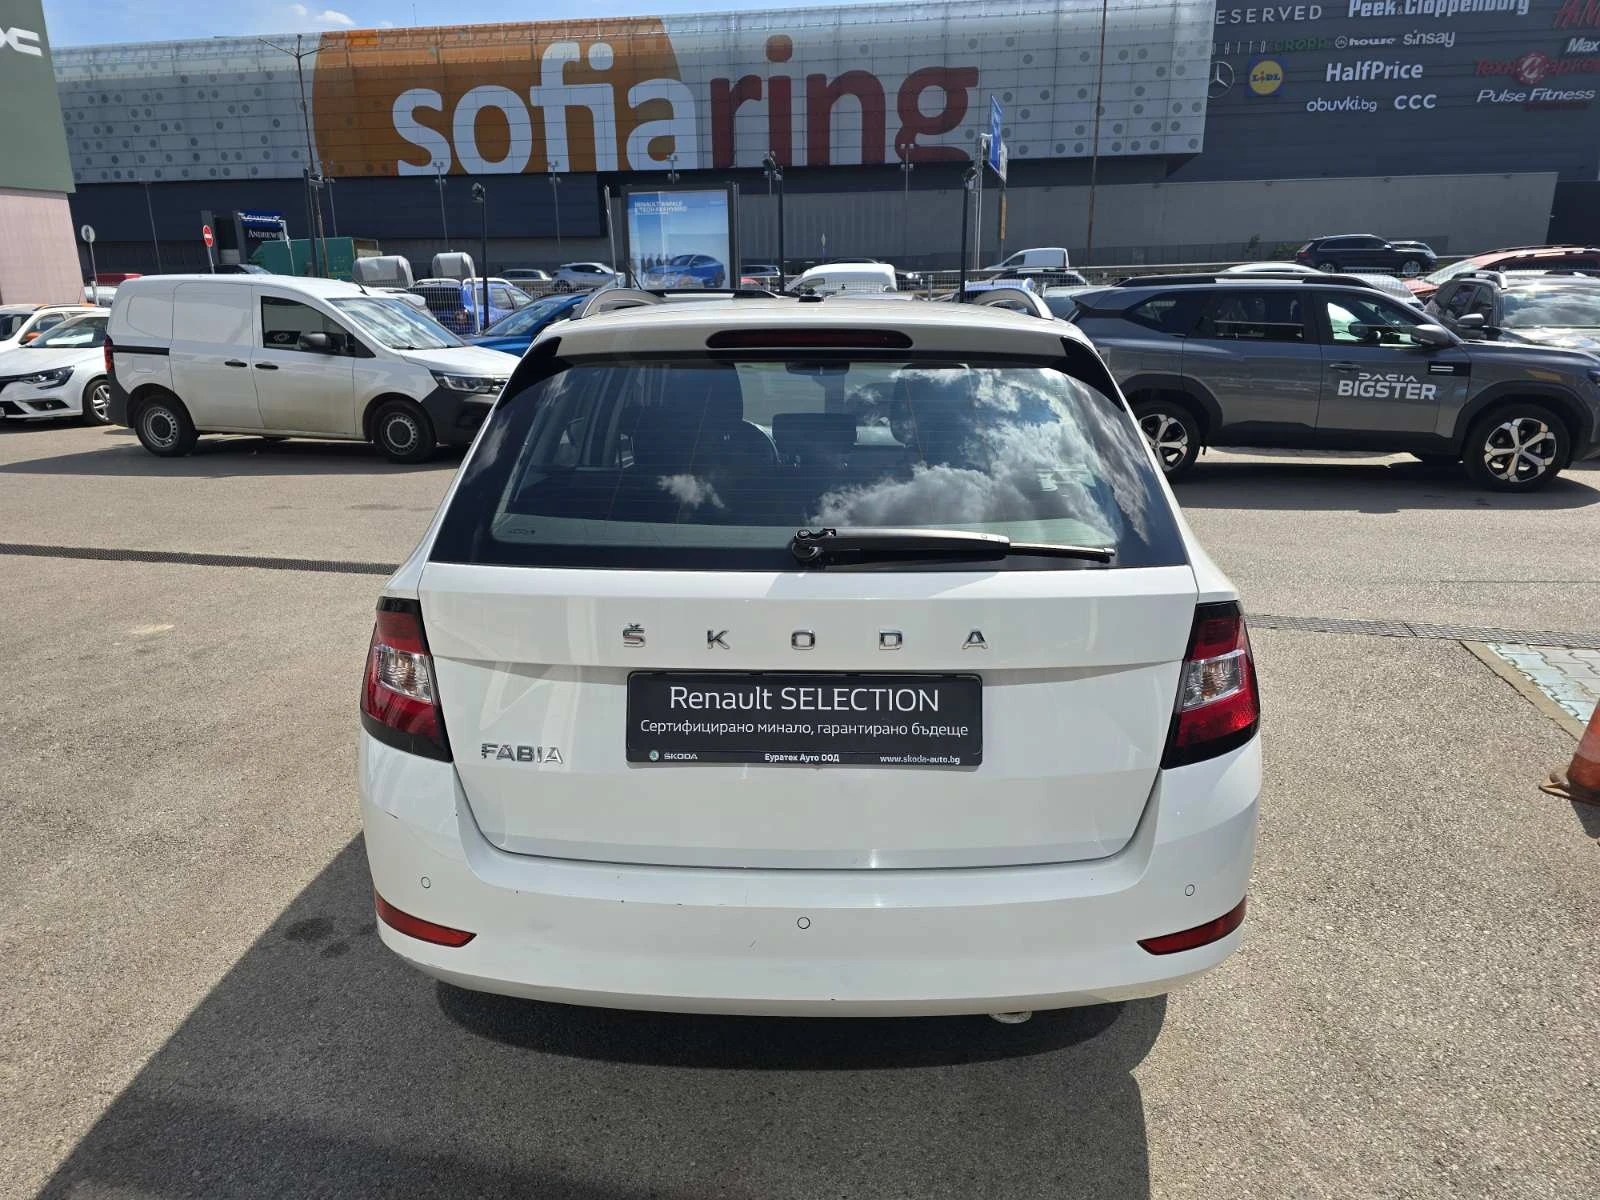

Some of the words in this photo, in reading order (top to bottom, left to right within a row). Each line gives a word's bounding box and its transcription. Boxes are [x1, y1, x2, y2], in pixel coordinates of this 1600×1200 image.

[1215, 5, 1322, 25] ESERVED
[1403, 29, 1455, 47] sinsay
[1326, 60, 1423, 82] HalfPrice
[1306, 95, 1377, 112] obuvki.bg
[1394, 94, 1437, 110] CCC
[1476, 89, 1527, 103] Pulse
[1529, 88, 1597, 102] Fitness
[1337, 379, 1437, 401] BIGSTER
[670, 685, 773, 710] Renault
[781, 687, 939, 712] SELECTION
[640, 719, 754, 736] Сертифицирано
[757, 722, 815, 736] минало,
[817, 724, 908, 738] гарантирано
[911, 722, 969, 738] бъдеще
[481, 743, 563, 764] FABIA
[879, 754, 961, 765] www.skoda-auto.bg
